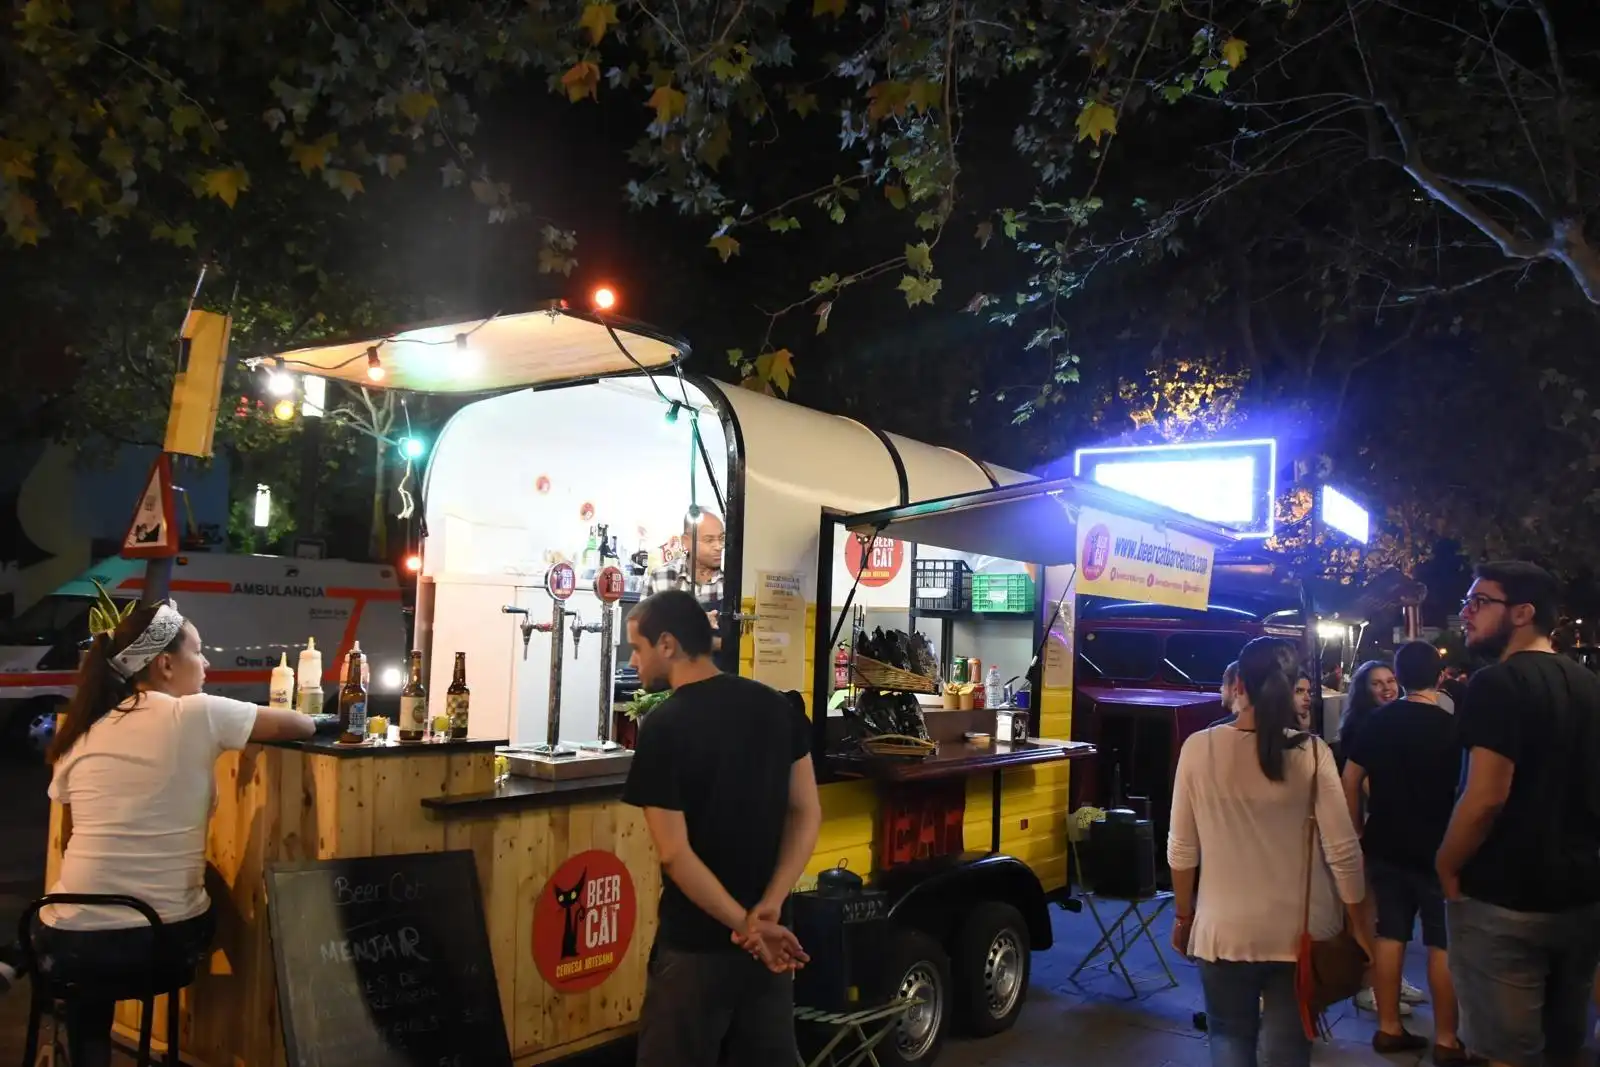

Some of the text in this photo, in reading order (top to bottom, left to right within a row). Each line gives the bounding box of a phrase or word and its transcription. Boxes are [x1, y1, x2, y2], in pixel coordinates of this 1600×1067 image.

[873, 548, 894, 568] CAT
[233, 583, 325, 598] AMBULANCIA
[334, 876, 384, 902] Beer
[587, 874, 621, 909] BEER
[585, 903, 620, 949] CAT
[319, 926, 431, 964] MENJAR
[556, 952, 613, 978] CERVESA ARTESANA
